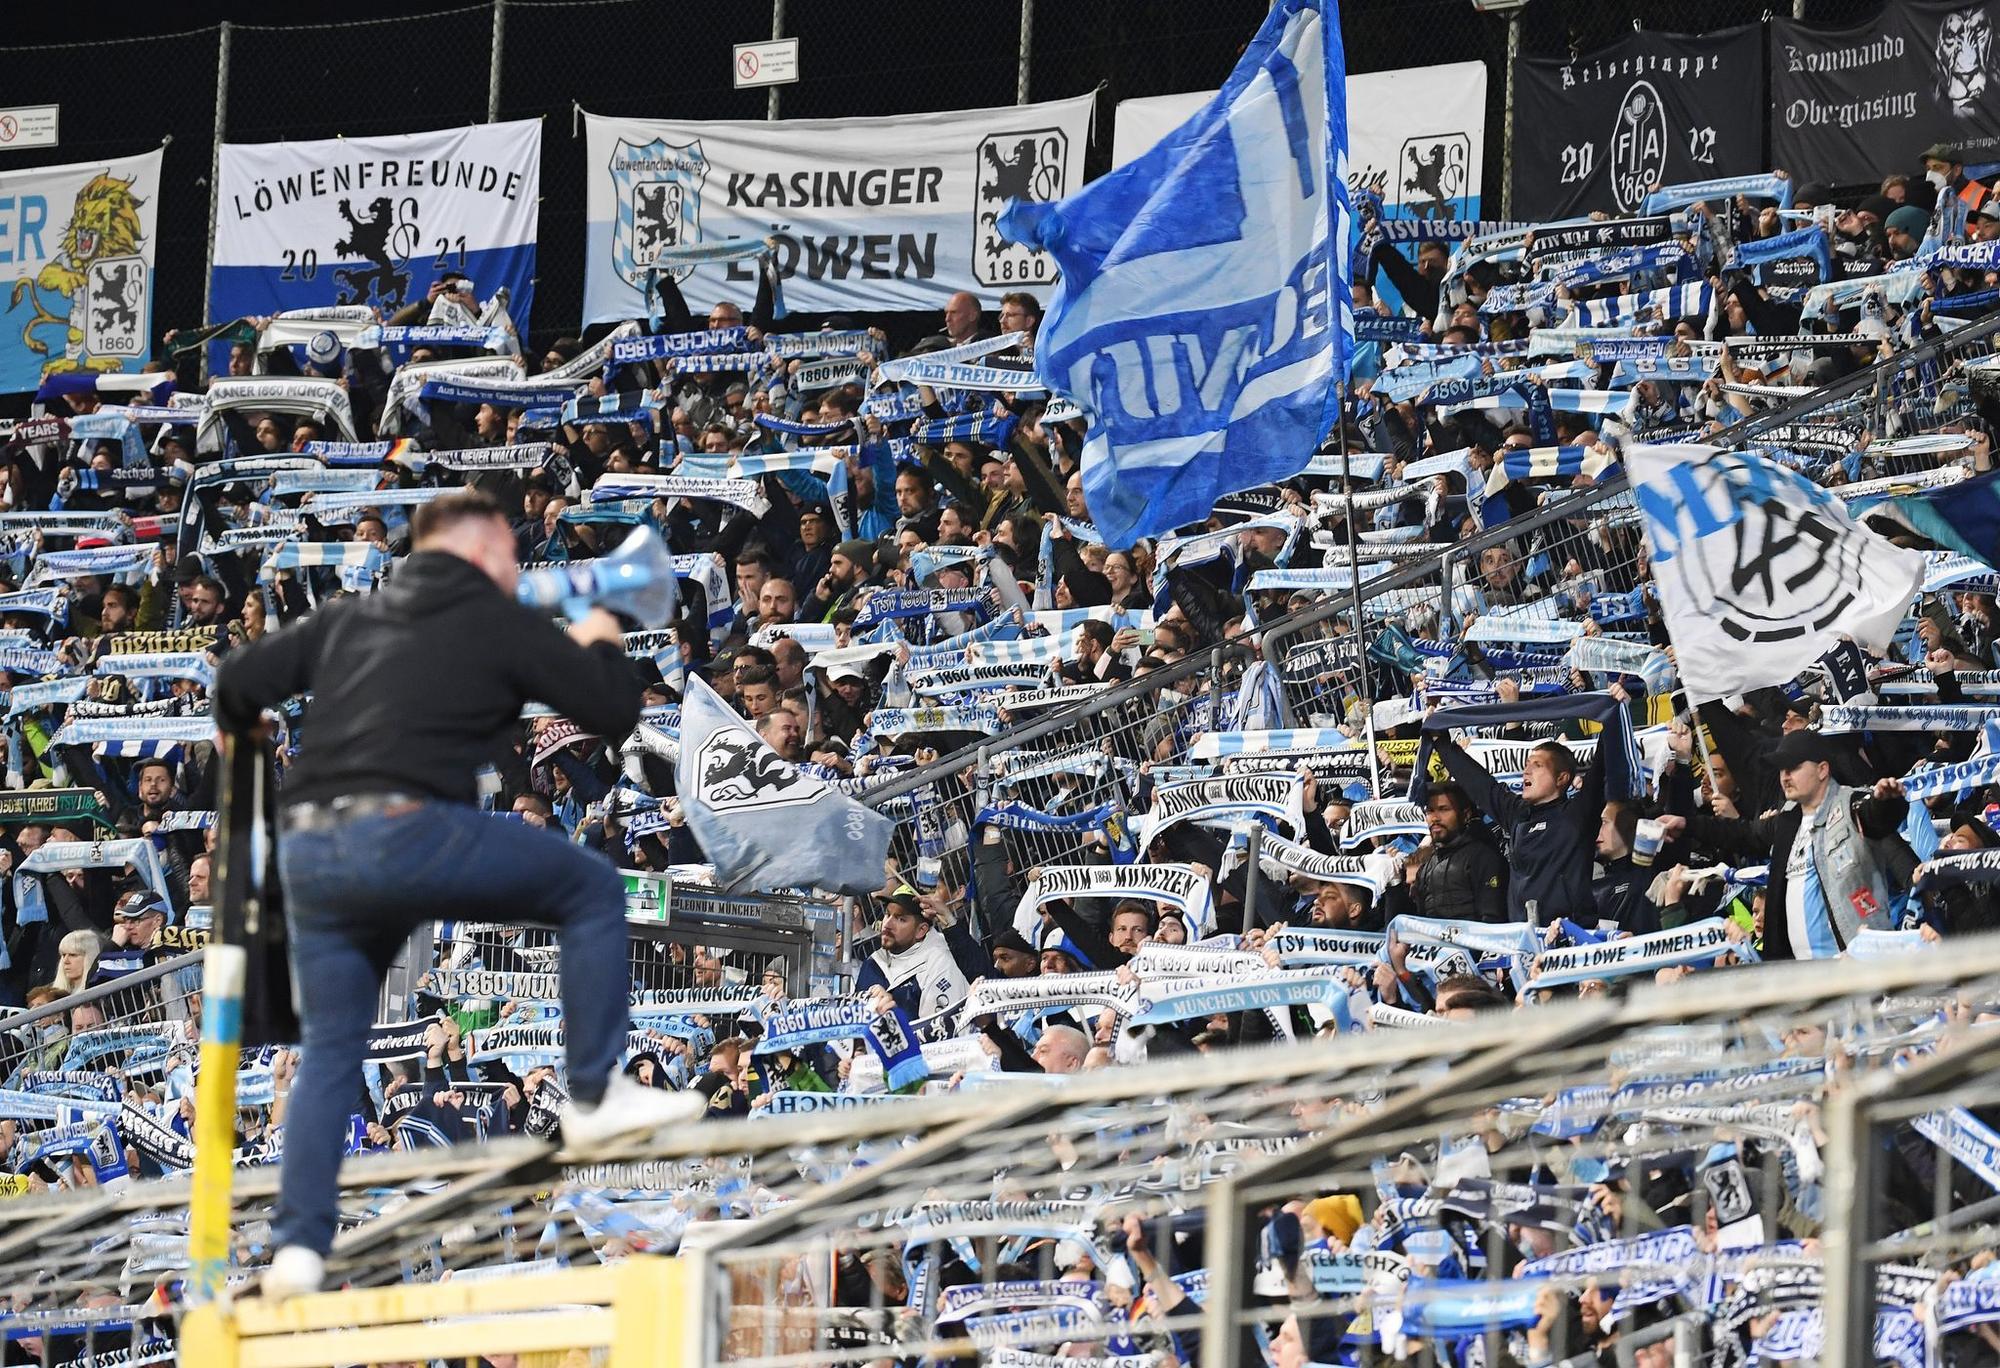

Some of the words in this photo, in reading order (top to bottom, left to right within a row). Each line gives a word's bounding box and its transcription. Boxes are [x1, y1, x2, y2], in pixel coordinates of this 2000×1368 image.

[1785, 33, 1905, 74] Kommando
[1560, 142, 1594, 184] 20
[235, 160, 522, 220] LÖWENFREUNDE
[726, 166, 943, 207] KASINGER
[1379, 220, 1419, 240] TSV
[1423, 220, 1474, 240] 1860
[280, 249, 317, 281] 20
[435, 237, 467, 270] 21
[726, 224, 938, 282] LÖWEN
[988, 260, 1045, 281] 1860
[99, 337, 134, 350] 1860
[614, 337, 657, 358] 1860
[800, 370, 830, 384] 1860
[949, 365, 995, 385] TREU
[1000, 368, 1022, 385] ZU
[438, 385, 456, 396] Aus
[19, 421, 60, 440] YEARS
[461, 448, 490, 465] NEVER
[491, 446, 517, 464] WALK
[873, 591, 898, 614] TSV
[901, 588, 930, 607] 1860
[936, 669, 970, 686] 1860
[1008, 690, 1046, 706] 1860
[879, 715, 906, 730] 1860
[1483, 748, 1528, 775] LEONU
[27, 797, 54, 816] JAHRE
[1038, 867, 1091, 897] EONUM
[1094, 870, 1112, 884] 1860
[680, 898, 715, 913] LEONUM
[719, 900, 762, 918] MÜNCHEN
[1274, 935, 1305, 954] TSV
[1584, 947, 1627, 968] LÖWE
[1643, 934, 1693, 959] IMMER
[1699, 928, 1727, 946] LÖW
[1133, 955, 1157, 973] TSV
[455, 971, 507, 997] 1860
[512, 973, 561, 1000] MÜN
[1173, 992, 1246, 1015] MÜNCHEN
[1250, 989, 1281, 1005] VON
[1286, 983, 1323, 1001] 1860
[771, 1012, 804, 1035] 1860
[922, 1204, 951, 1227] TSV
[958, 1201, 993, 1221] 1860
